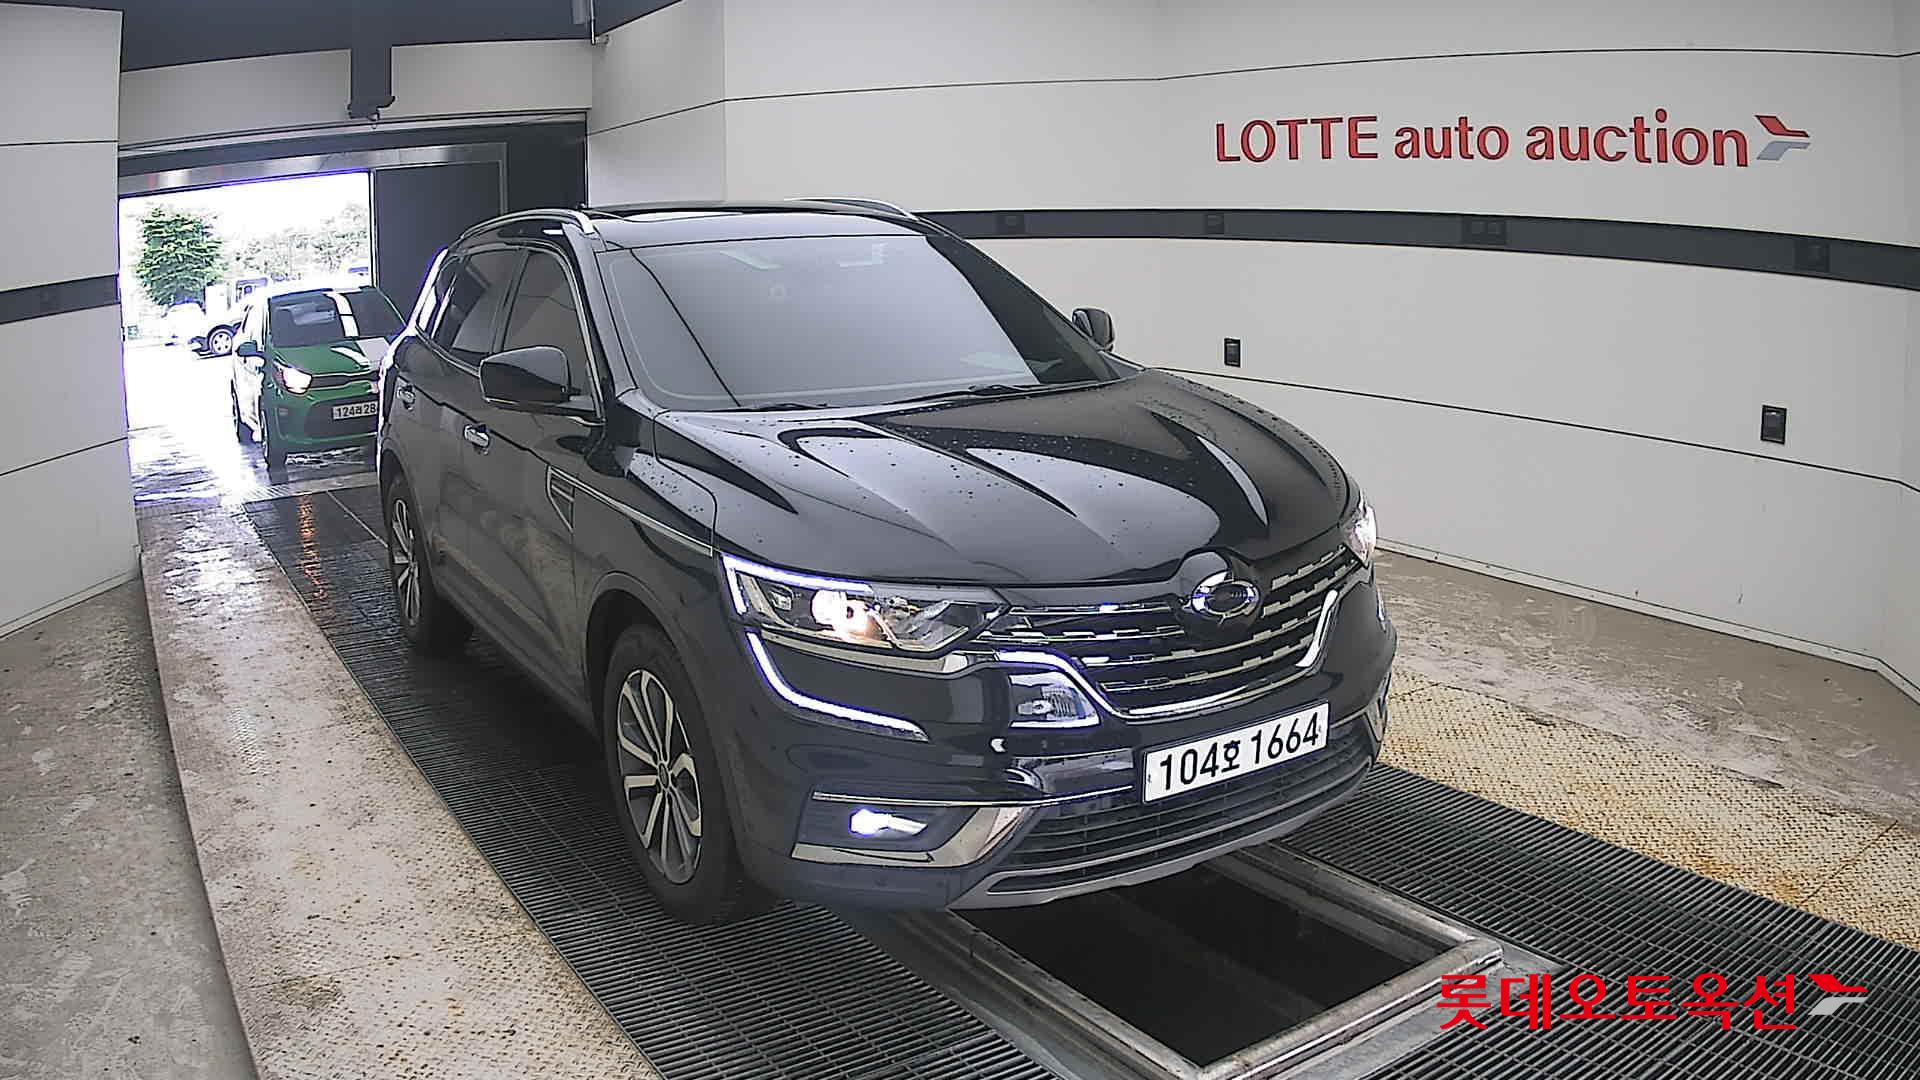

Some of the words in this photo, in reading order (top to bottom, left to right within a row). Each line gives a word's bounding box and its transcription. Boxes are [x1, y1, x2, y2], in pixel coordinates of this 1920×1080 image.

[1215, 115, 1378, 163] LOTTE
[1394, 115, 1509, 161] auto
[1524, 107, 1749, 168] auction
[1159, 740, 1240, 790] 104호
[1250, 711, 1319, 764] 1664
